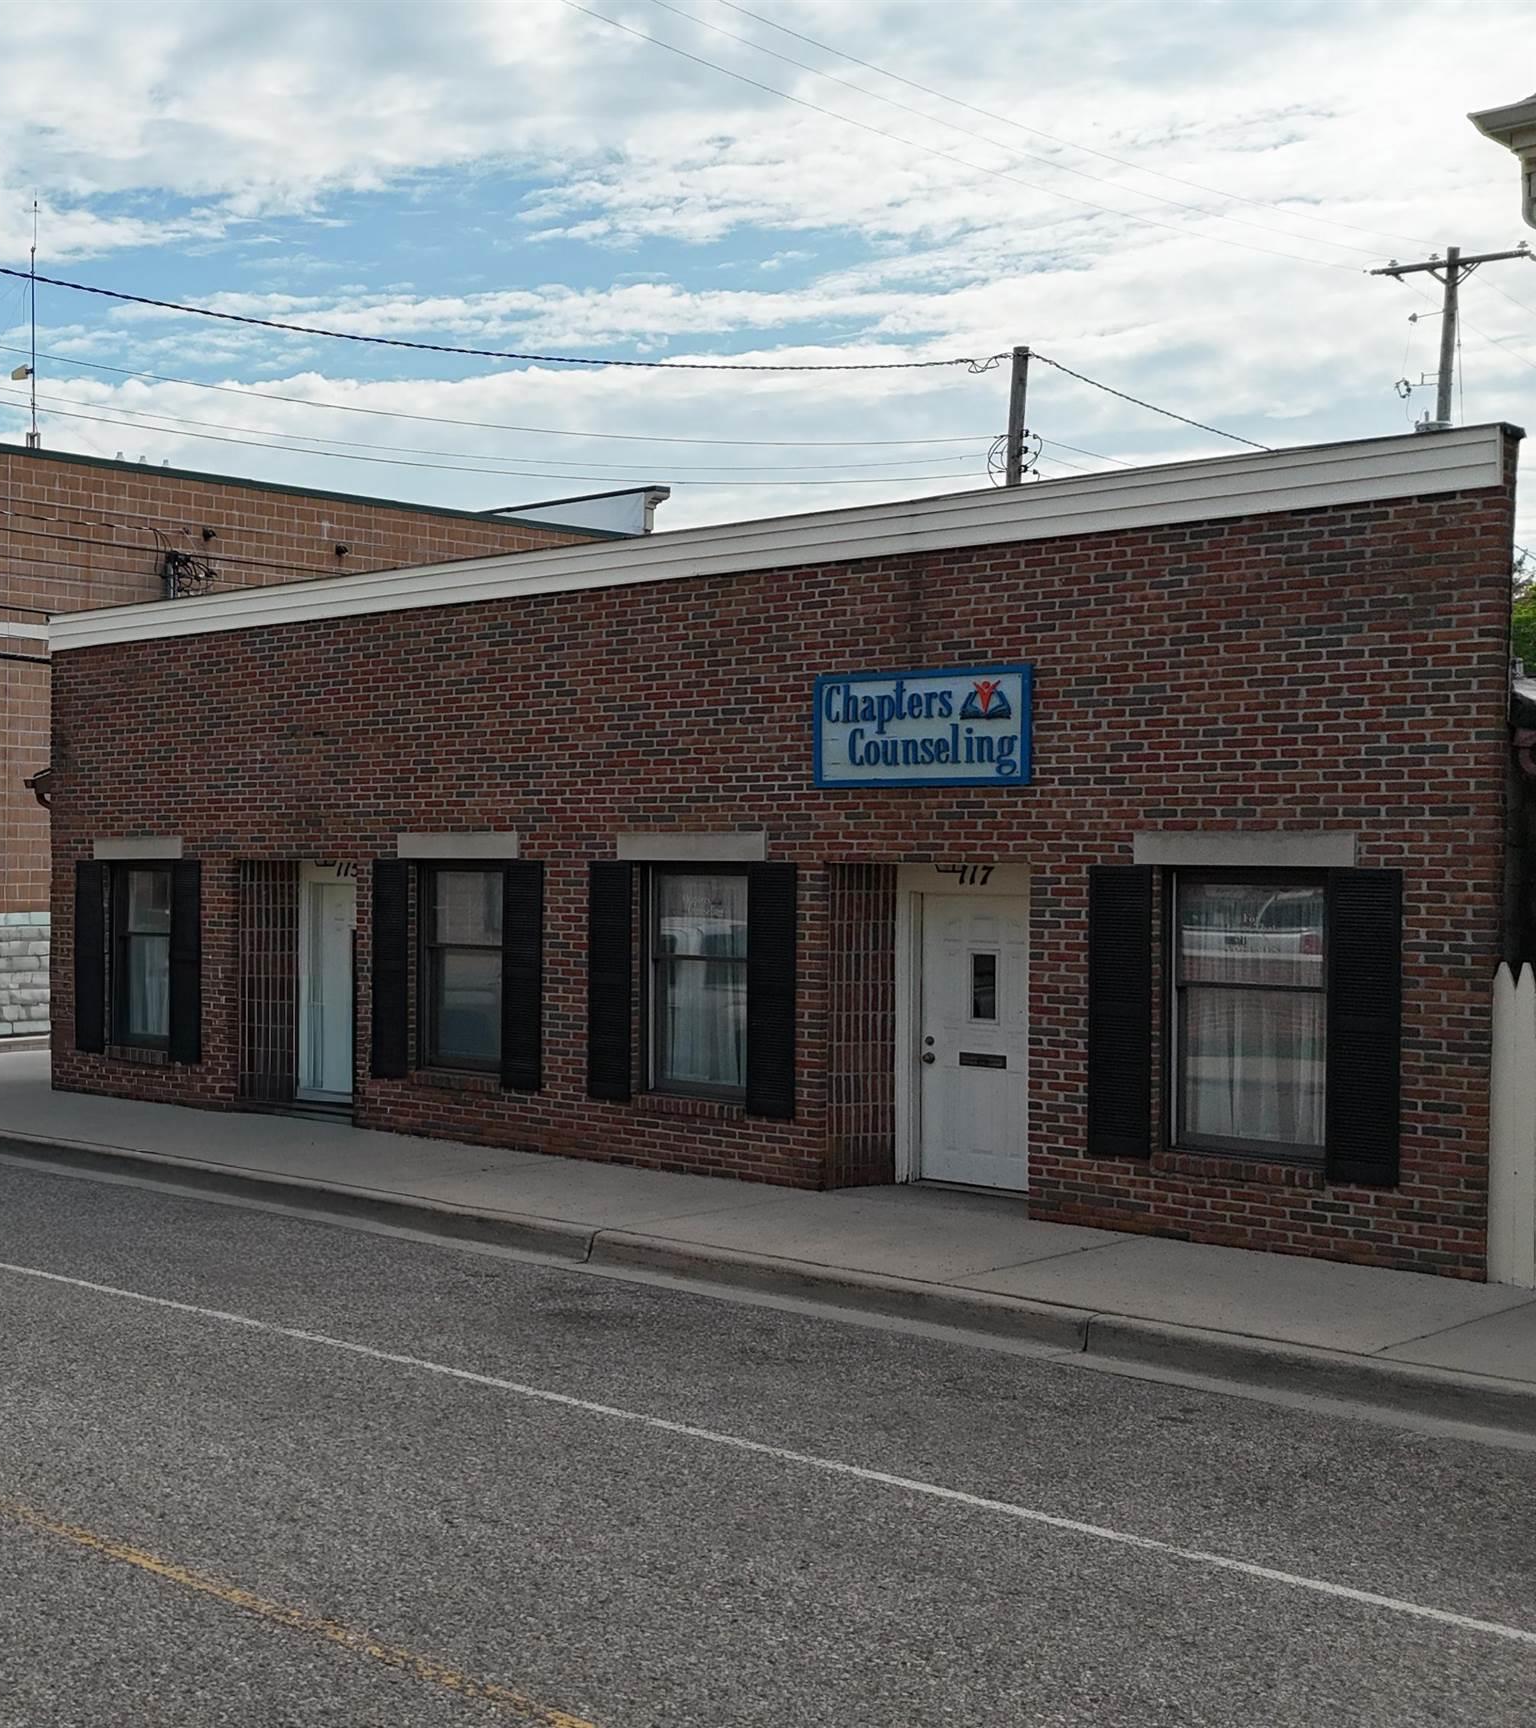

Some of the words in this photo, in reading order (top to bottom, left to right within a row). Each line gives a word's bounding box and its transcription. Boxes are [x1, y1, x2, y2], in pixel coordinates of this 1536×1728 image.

[825, 680, 953, 734] Chapters
[848, 723, 1018, 776] Counseling
[336, 861, 358, 877] 115
[959, 863, 995, 886] 117
